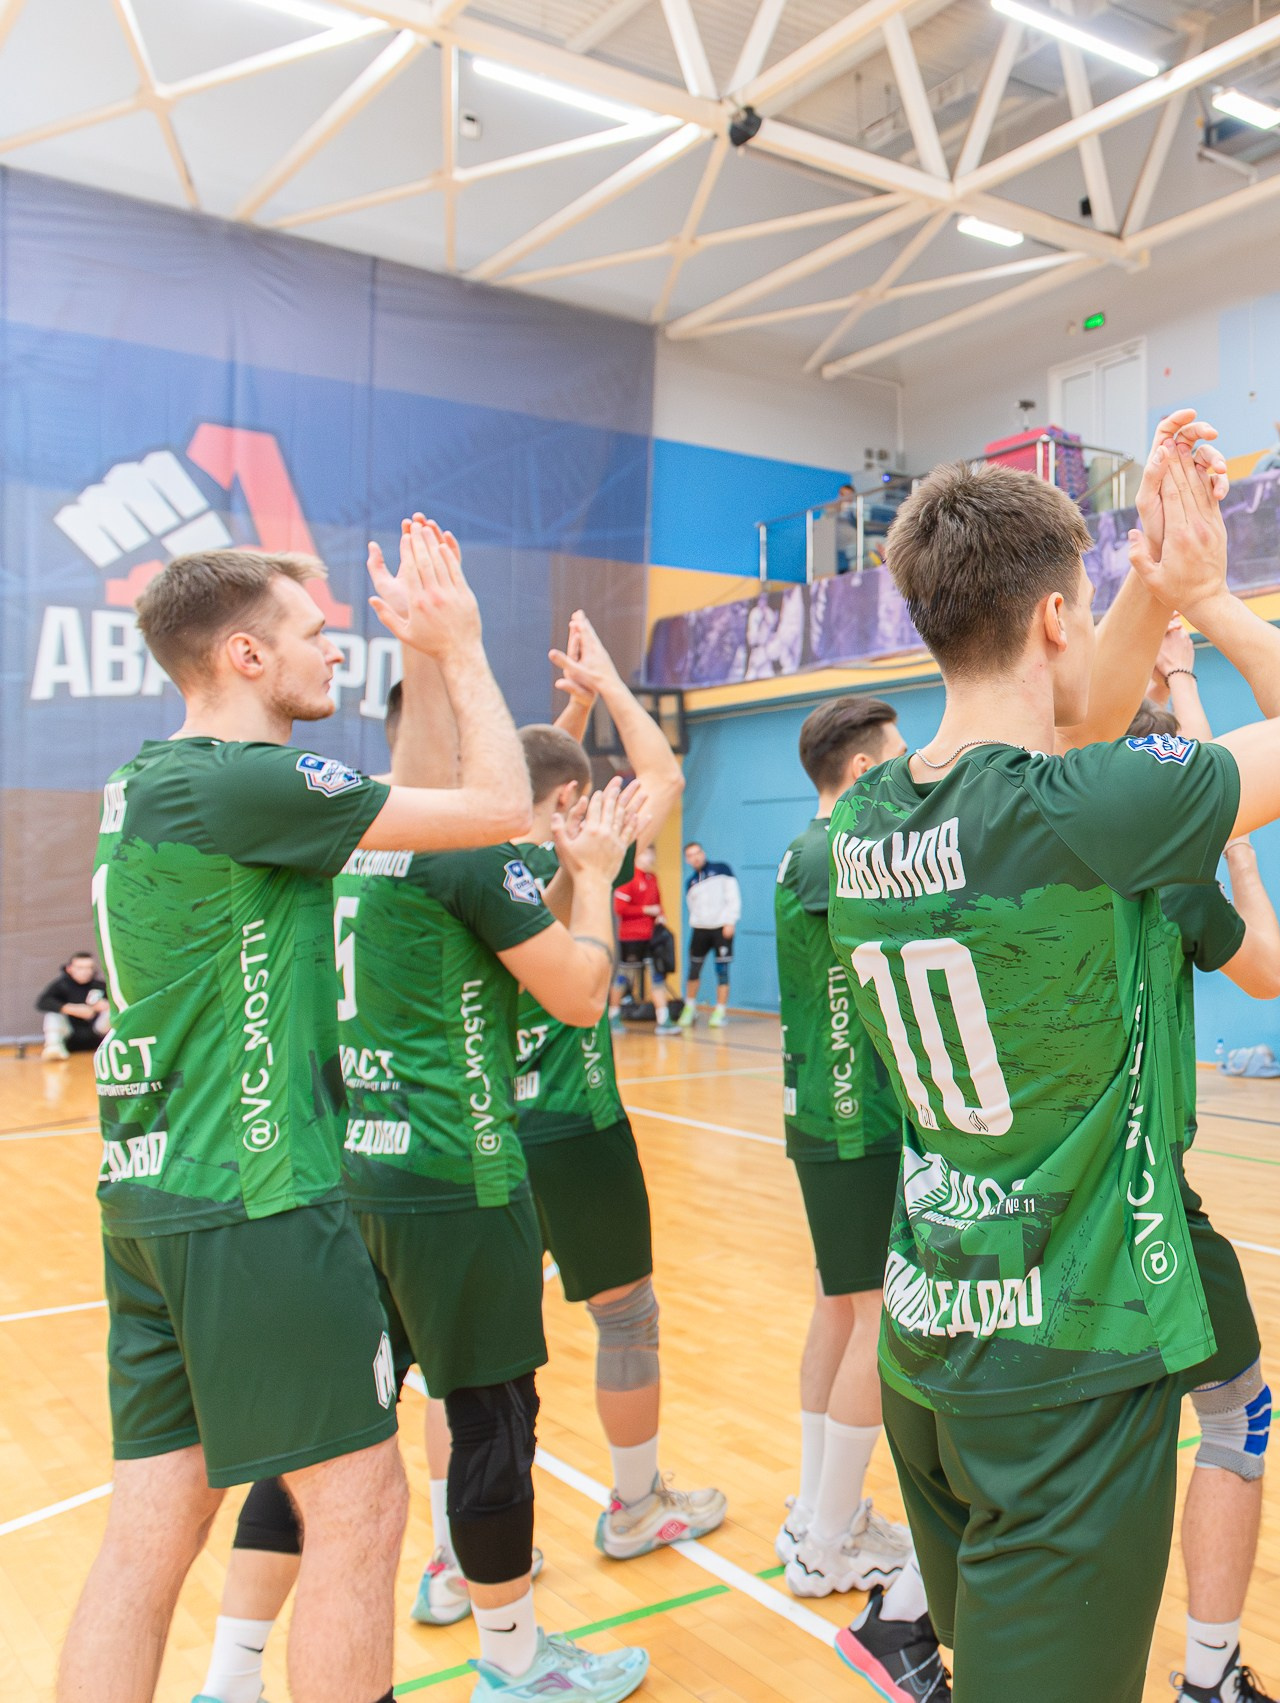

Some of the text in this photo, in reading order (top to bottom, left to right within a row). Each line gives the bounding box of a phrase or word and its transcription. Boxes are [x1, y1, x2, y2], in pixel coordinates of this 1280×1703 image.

[240, 919, 280, 1153] @VC_MOST11
[828, 965, 859, 1119] @VC_MOST11
[851, 937, 1014, 1137] 10
[1023, 1198, 1036, 1213] 11
